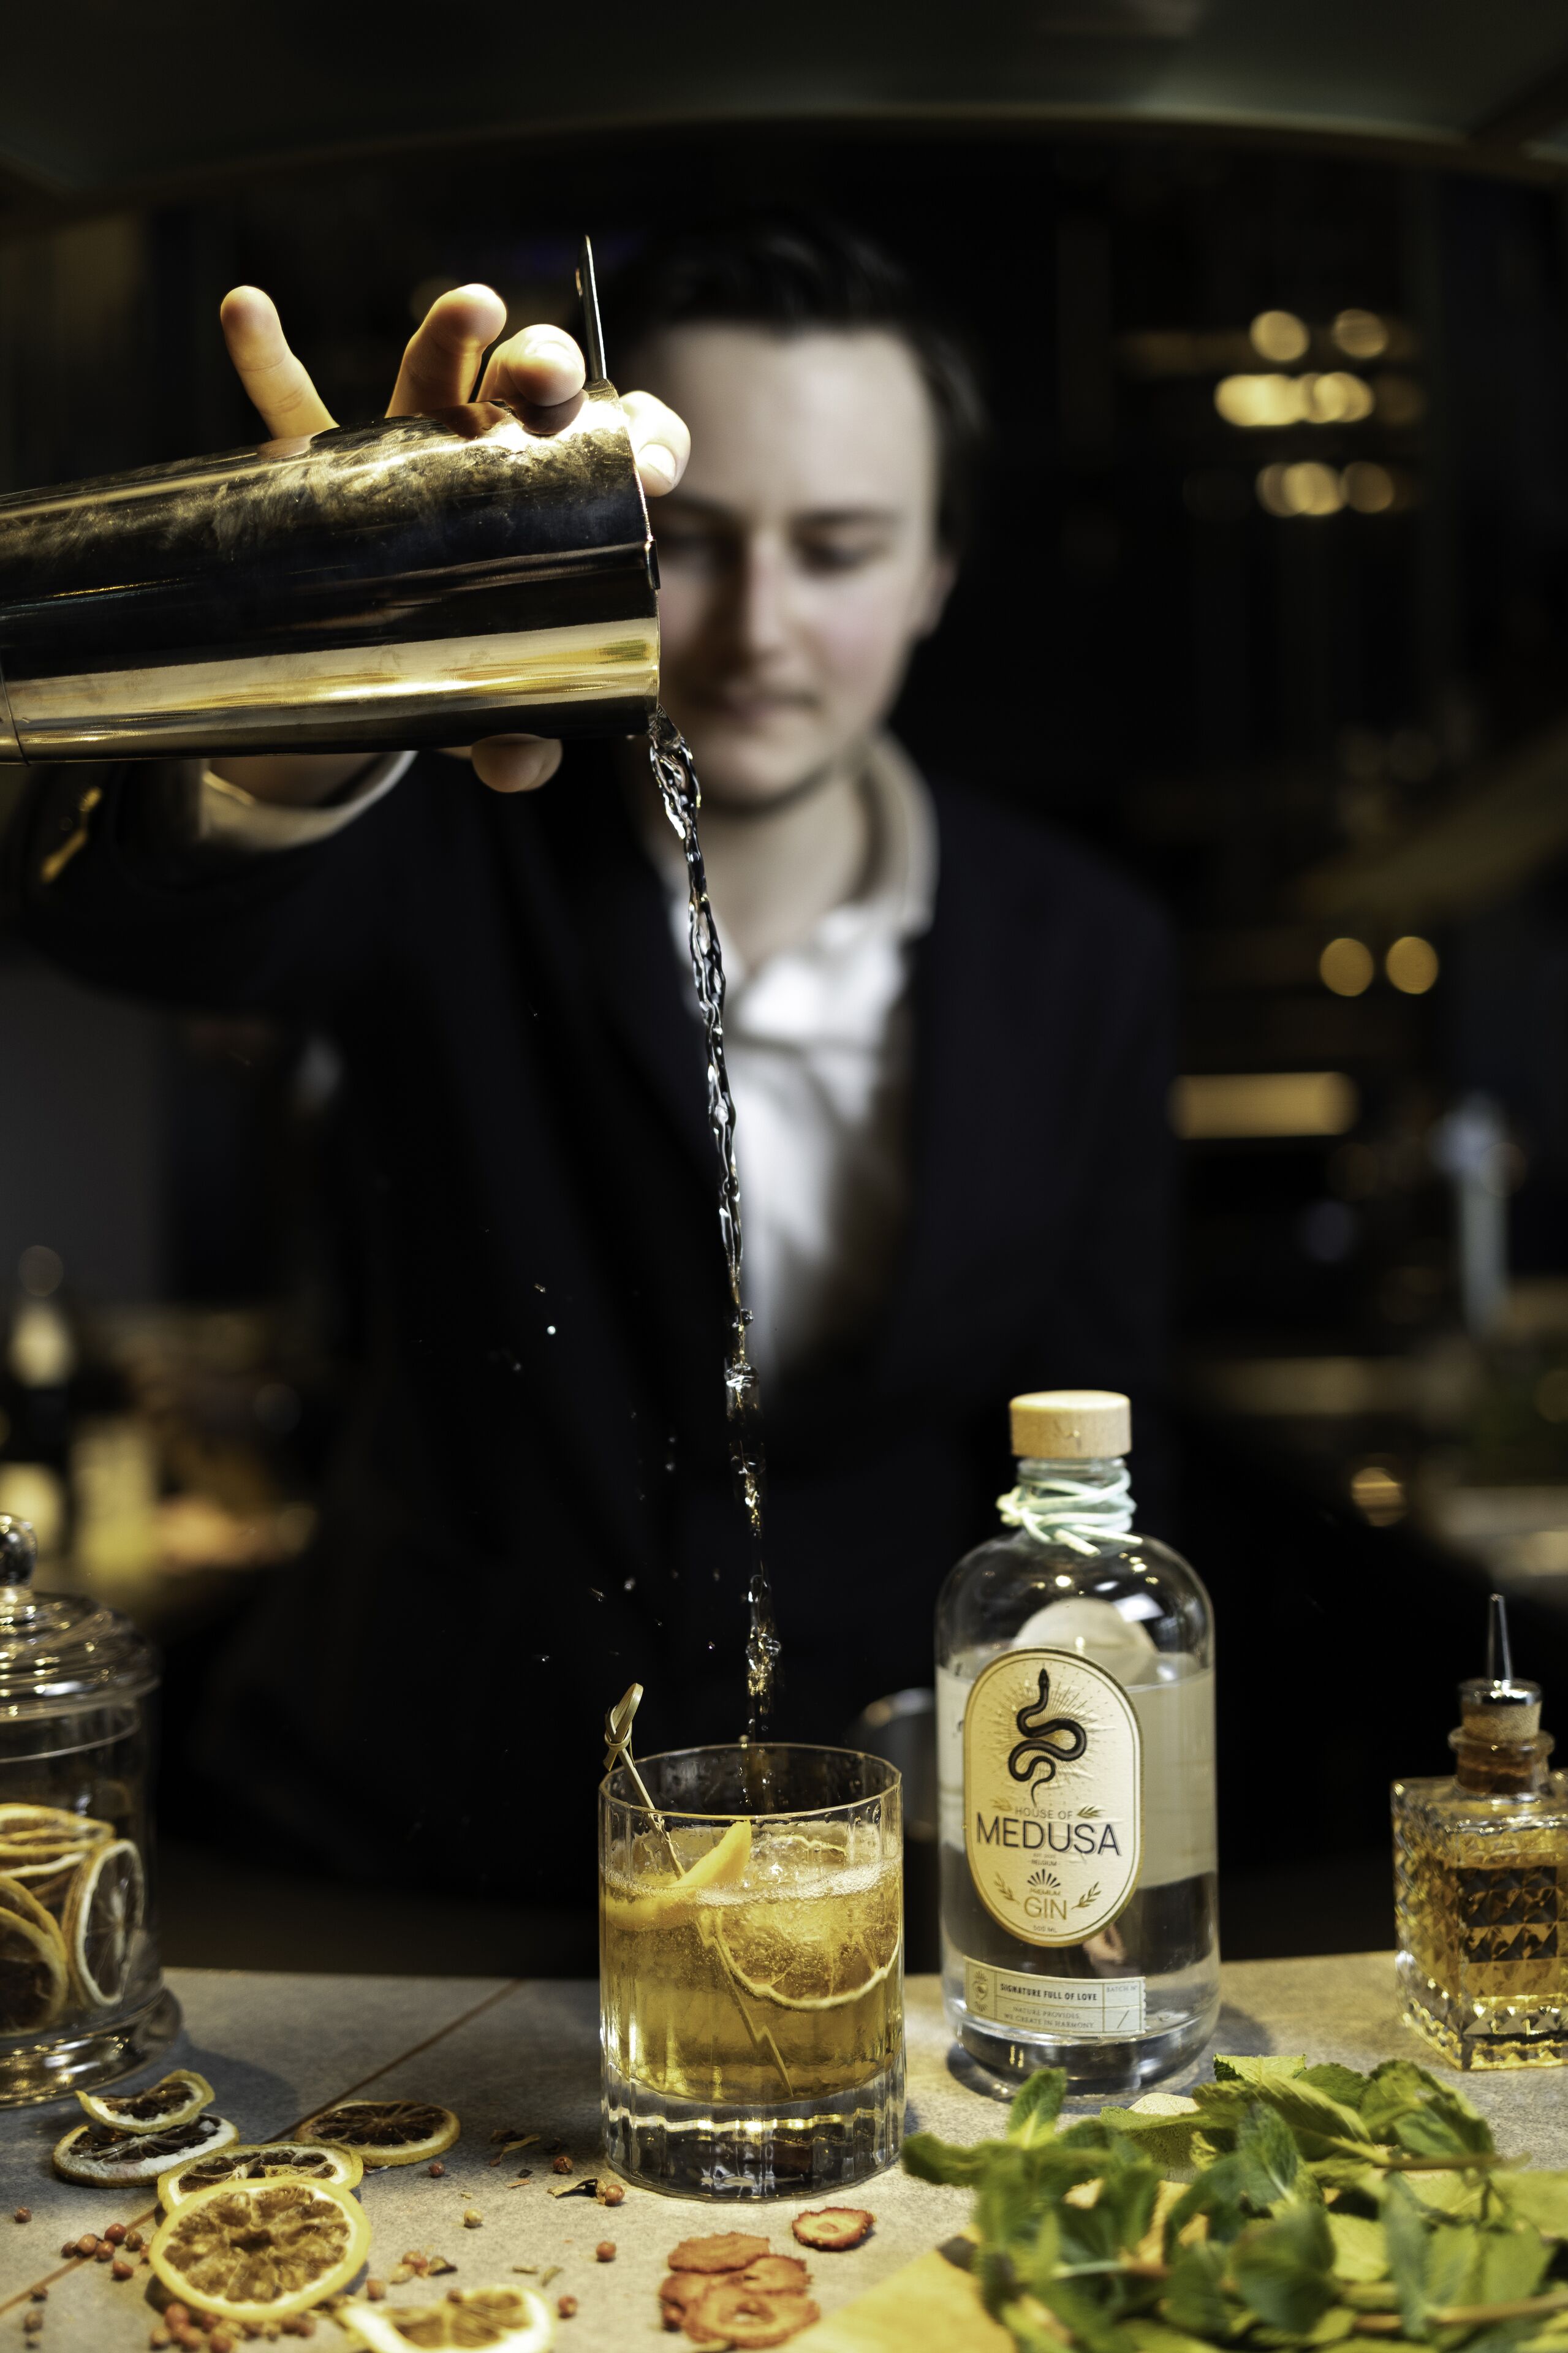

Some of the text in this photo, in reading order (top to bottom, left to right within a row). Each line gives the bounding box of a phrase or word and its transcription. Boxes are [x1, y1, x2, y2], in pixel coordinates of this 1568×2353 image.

[1015, 1806, 1074, 1820] HOUSE OF
[976, 1811, 1122, 1857] MEDUSA
[1024, 1896, 1067, 1920] GIN
[1000, 1983, 1041, 1998] SIGNATURE
[1043, 1990, 1062, 1999] FULL
